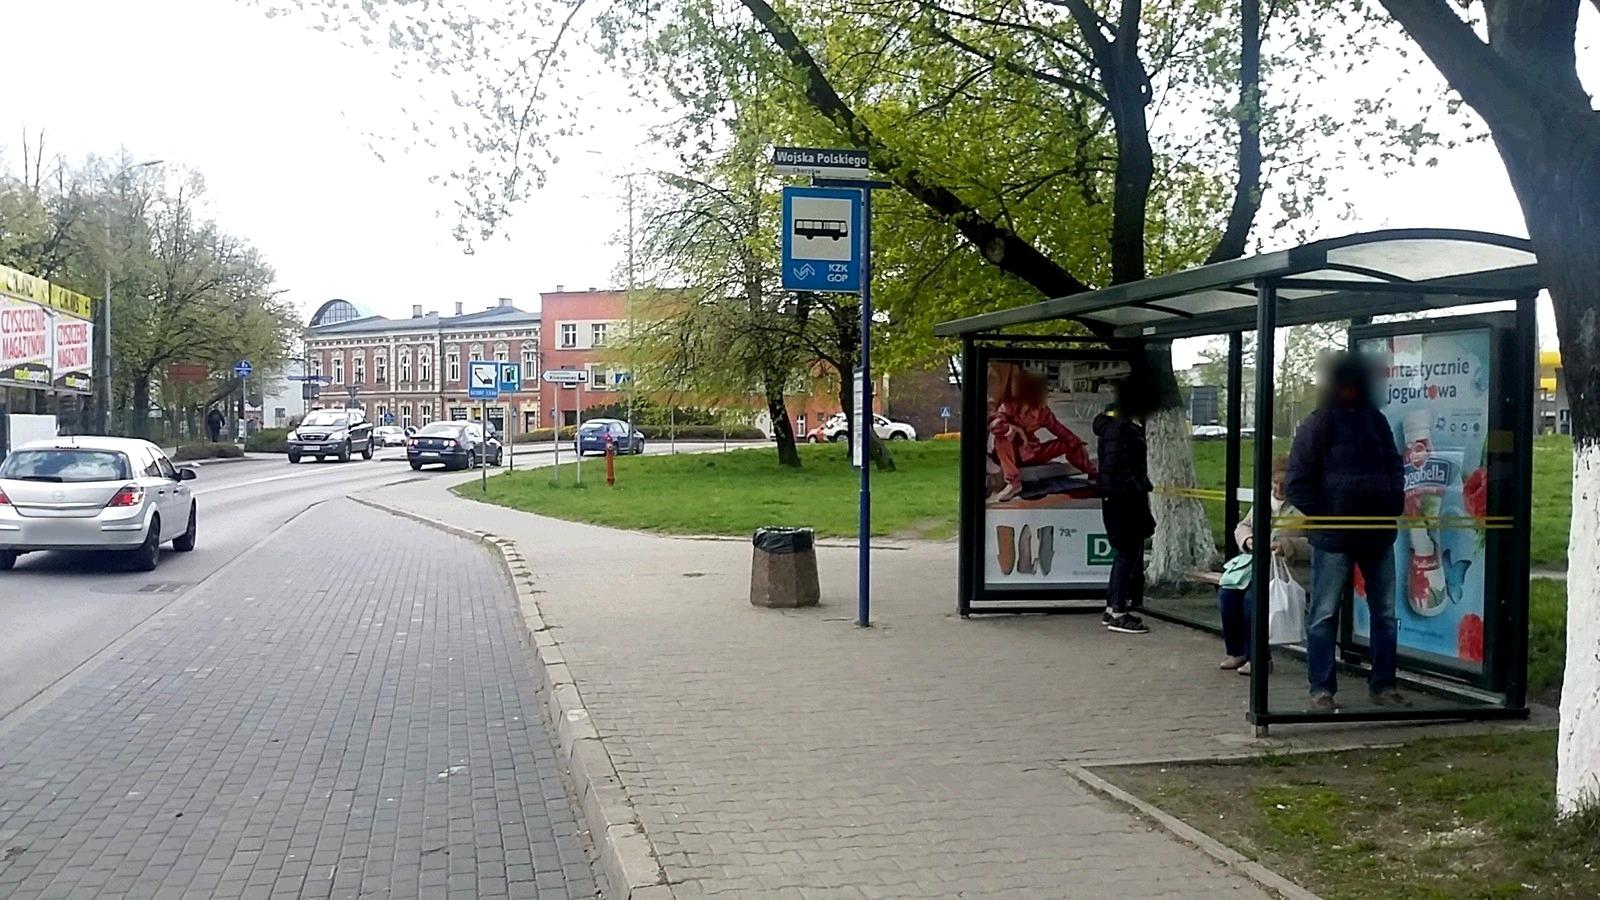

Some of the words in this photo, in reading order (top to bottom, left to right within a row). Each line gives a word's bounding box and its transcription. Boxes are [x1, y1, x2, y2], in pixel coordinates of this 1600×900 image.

[776, 151, 814, 164] Wojska
[816, 153, 867, 167] Polskiego
[827, 273, 848, 282] GOP
[828, 264, 848, 272] KZK
[1, 309, 46, 333] CZYSZCZENIE
[56, 323, 87, 346] CZYSZCZENIE
[1383, 358, 1470, 380] antastycznie
[1387, 384, 1457, 404] jogurtowa
